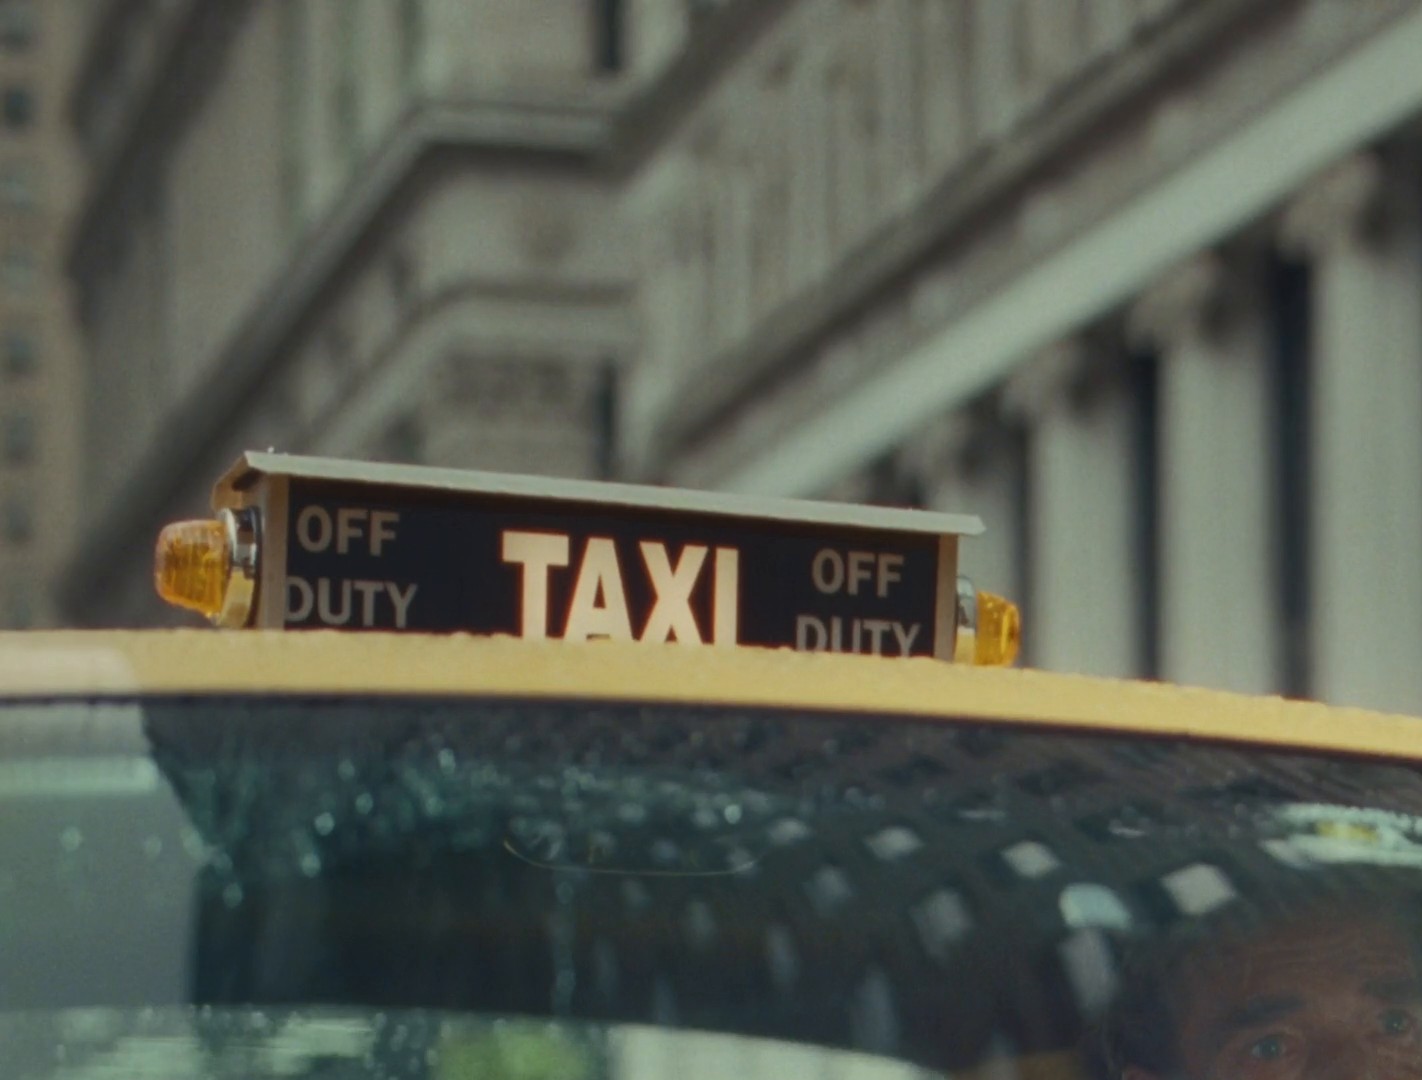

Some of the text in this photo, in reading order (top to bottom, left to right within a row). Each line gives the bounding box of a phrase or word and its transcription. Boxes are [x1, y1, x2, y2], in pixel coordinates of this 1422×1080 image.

[296, 504, 399, 557] OFF
[502, 529, 740, 646] TAXI
[812, 548, 903, 597] OFF
[286, 576, 417, 629] DUTY
[797, 615, 921, 659] DUTY
